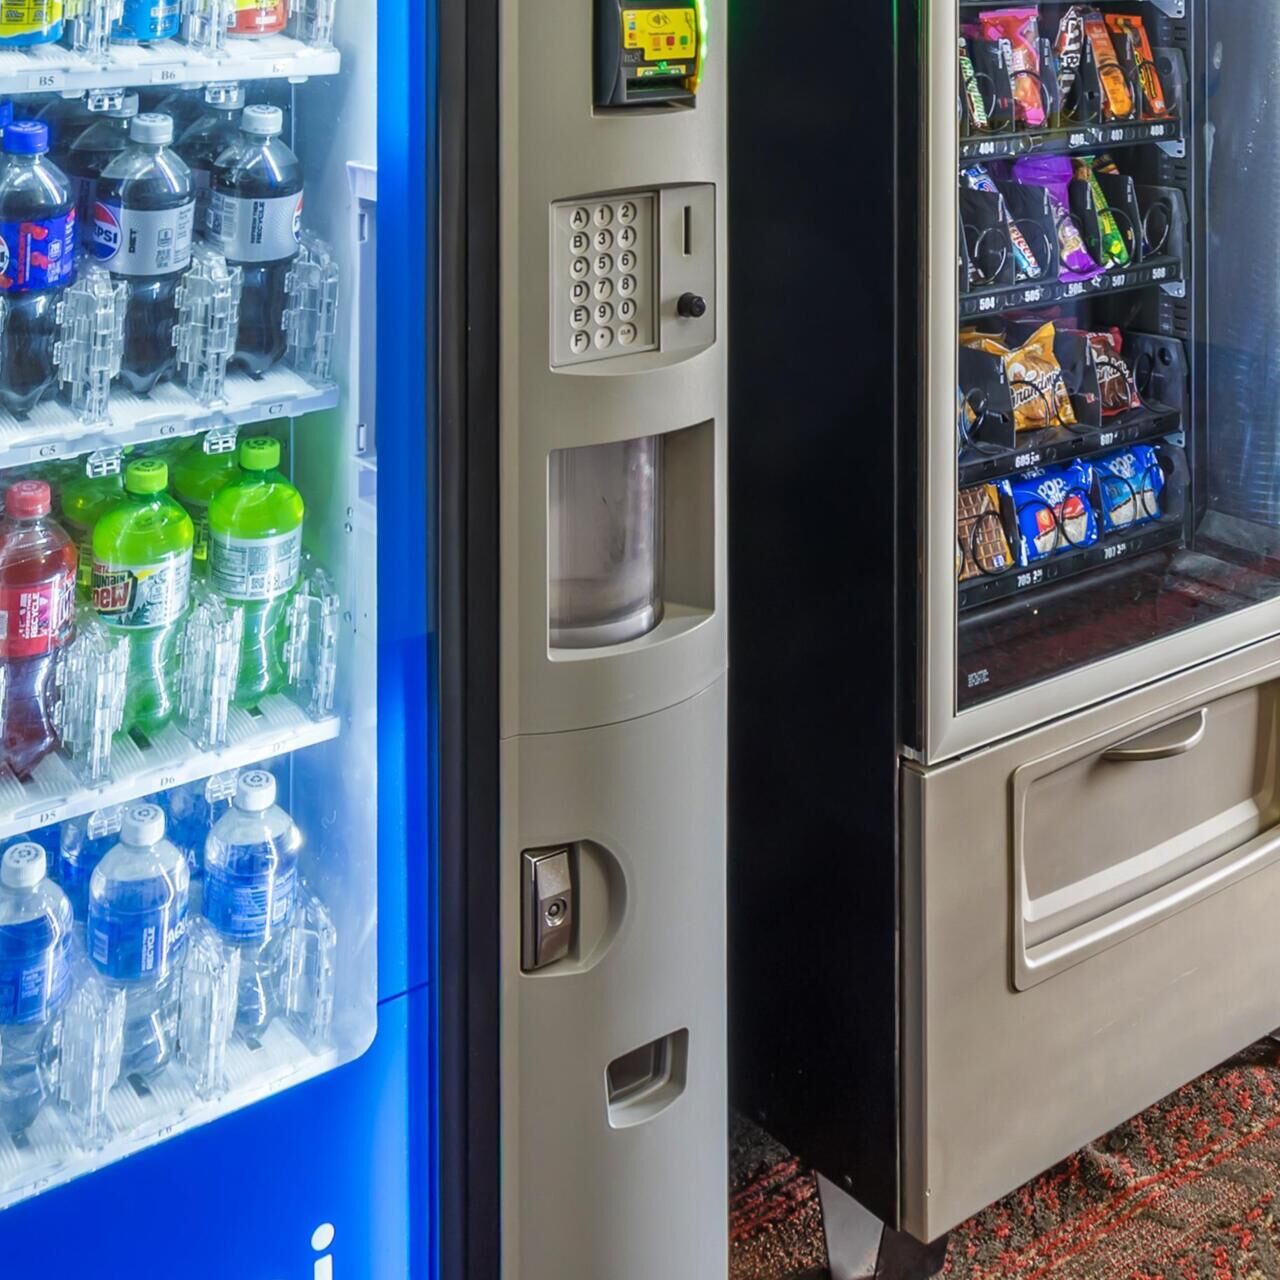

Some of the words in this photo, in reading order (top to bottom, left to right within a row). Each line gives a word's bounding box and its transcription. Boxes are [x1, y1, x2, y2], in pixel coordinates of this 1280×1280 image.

[39, 75, 55, 86] B5
[161, 70, 176, 81] B6
[1111, 129, 1124, 141] 407
[1150, 124, 1165, 136] 408
[1070, 133, 1085, 145] 406
[979, 141, 995, 154] 404
[573, 210, 583, 223] A
[599, 207, 604, 220] 1
[621, 205, 629, 218] 2
[256, 201, 265, 244] RECYCLE
[128, 227, 137, 253] DIET
[598, 232, 606, 245] 3
[621, 228, 629, 241] 4
[574, 235, 583, 248] B
[573, 259, 583, 273] C
[599, 256, 606, 269] 5
[621, 253, 629, 266] 6
[1152, 267, 1166, 279] 508
[598, 281, 606, 293] 7
[622, 277, 629, 290] 8
[1112, 275, 1126, 287] 507
[574, 284, 583, 297] D
[1025, 288, 1040, 302] 505
[1068, 283, 1083, 295] 506
[622, 301, 629, 315] 0
[979, 296, 995, 310] 504
[574, 308, 582, 322] E
[598, 305, 606, 318] 9
[575, 333, 583, 347] F
[268, 404, 284, 415] C7
[160, 425, 176, 436] C6
[1100, 433, 1113, 446] 607
[39, 446, 56, 457] C5
[1015, 454, 1030, 468] 605
[1104, 545, 1117, 559] 707
[1017, 573, 1031, 587] 705
[30, 592, 40, 639] RECYCLE
[159, 776, 176, 787] D6
[39, 812, 56, 823] D5
[146, 926, 155, 970] RECYCLE
